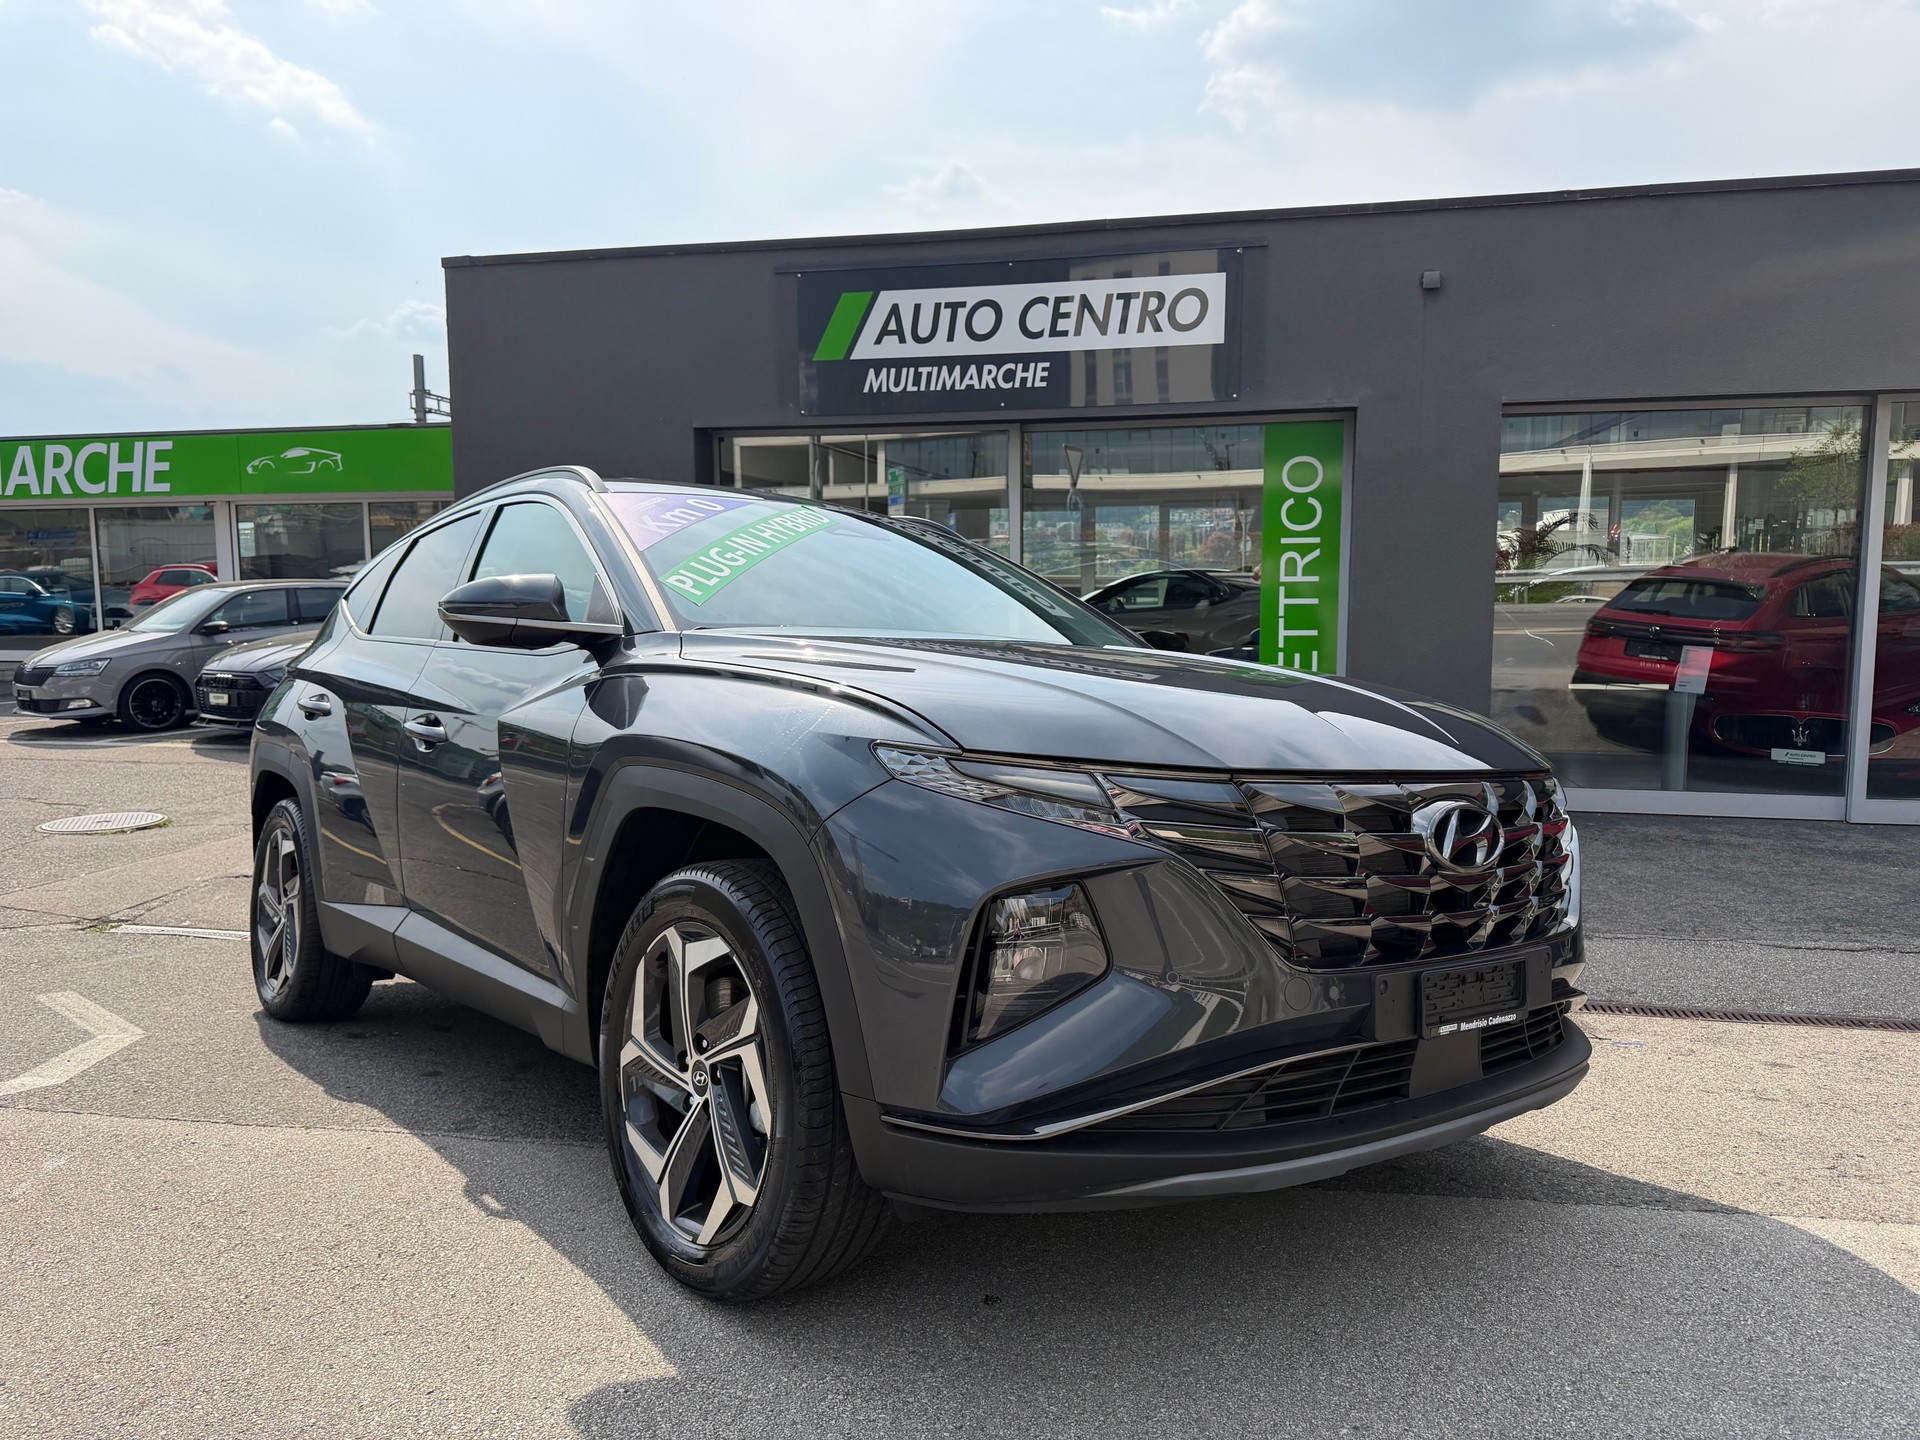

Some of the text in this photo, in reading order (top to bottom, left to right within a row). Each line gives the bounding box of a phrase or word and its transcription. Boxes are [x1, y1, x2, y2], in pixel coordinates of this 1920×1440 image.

[873, 287, 1209, 345] AUTO CENTRO
[862, 361, 1050, 393] MULTIMARCHE
[0, 440, 173, 496] ARCHE
[666, 533, 771, 596] PLUG-IN
[749, 504, 831, 543] HYBRID
[1460, 1018, 1487, 1031] Mendrisio
[1488, 1013, 1517, 1025] Cadenazzo
